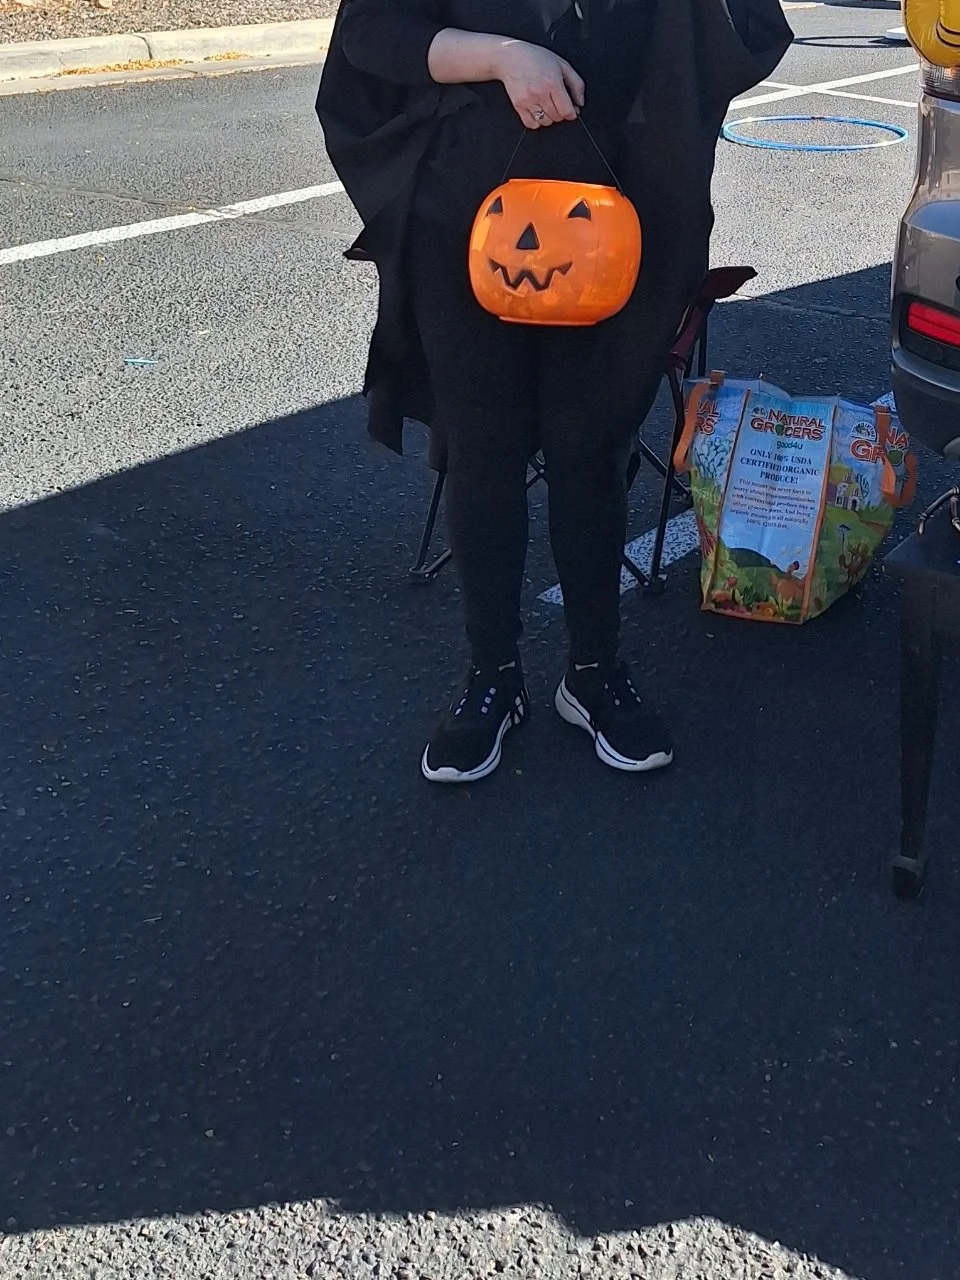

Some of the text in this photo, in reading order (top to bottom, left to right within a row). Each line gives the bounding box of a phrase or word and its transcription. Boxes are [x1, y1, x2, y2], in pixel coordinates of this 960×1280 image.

[769, 409, 825, 428] NATURAL
[750, 449, 772, 459] ONLY
[791, 456, 812, 465] USDA
[740, 457, 820, 476] CERTIFIED ORGANIC
[760, 471, 798, 484] PRODUCE!
